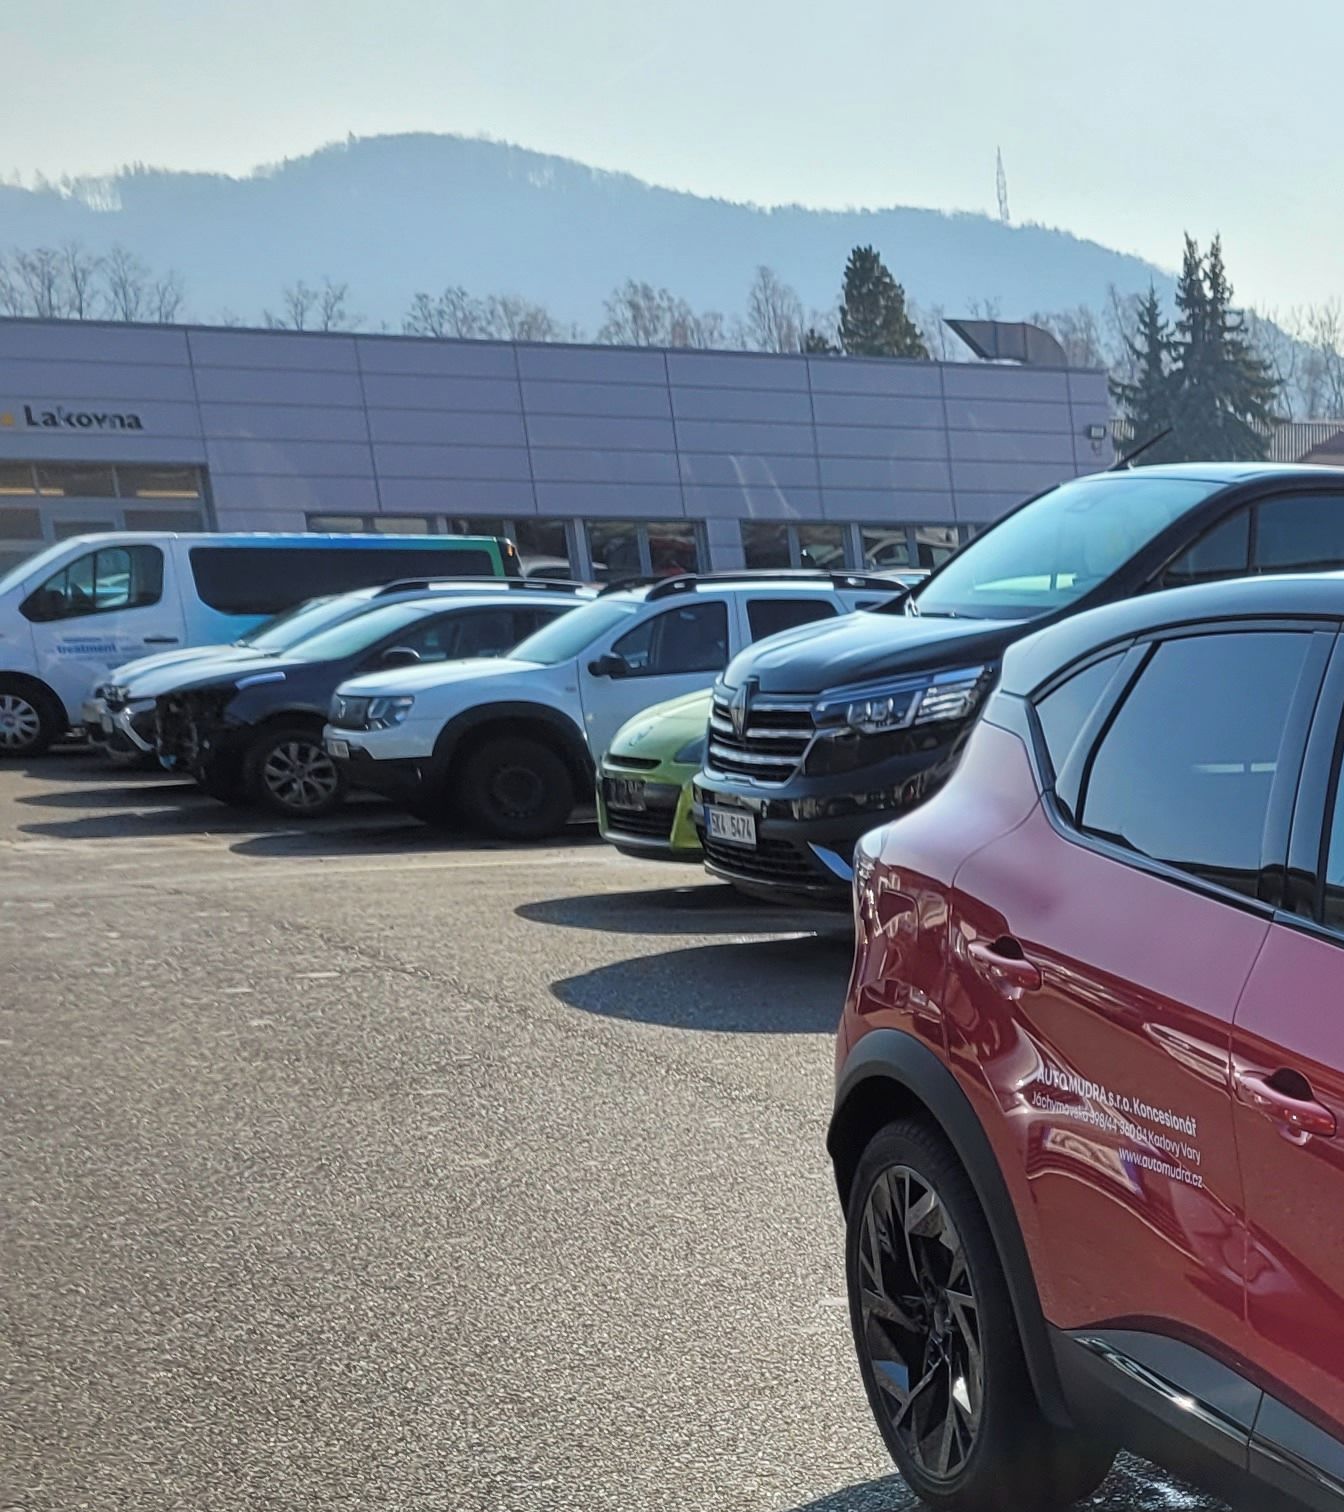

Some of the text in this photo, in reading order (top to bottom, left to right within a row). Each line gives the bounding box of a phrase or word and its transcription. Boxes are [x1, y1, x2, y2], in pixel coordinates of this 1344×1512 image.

[24, 404, 144, 430] Lakovna
[1108, 1092, 1133, 1112] s.r.o.
[1133, 1096, 1197, 1137] Koncesionář
[1148, 1129, 1181, 1157] Karlovy
[1181, 1142, 1201, 1166] Vary
[1118, 1147, 1203, 1188] www.automudra.cz
